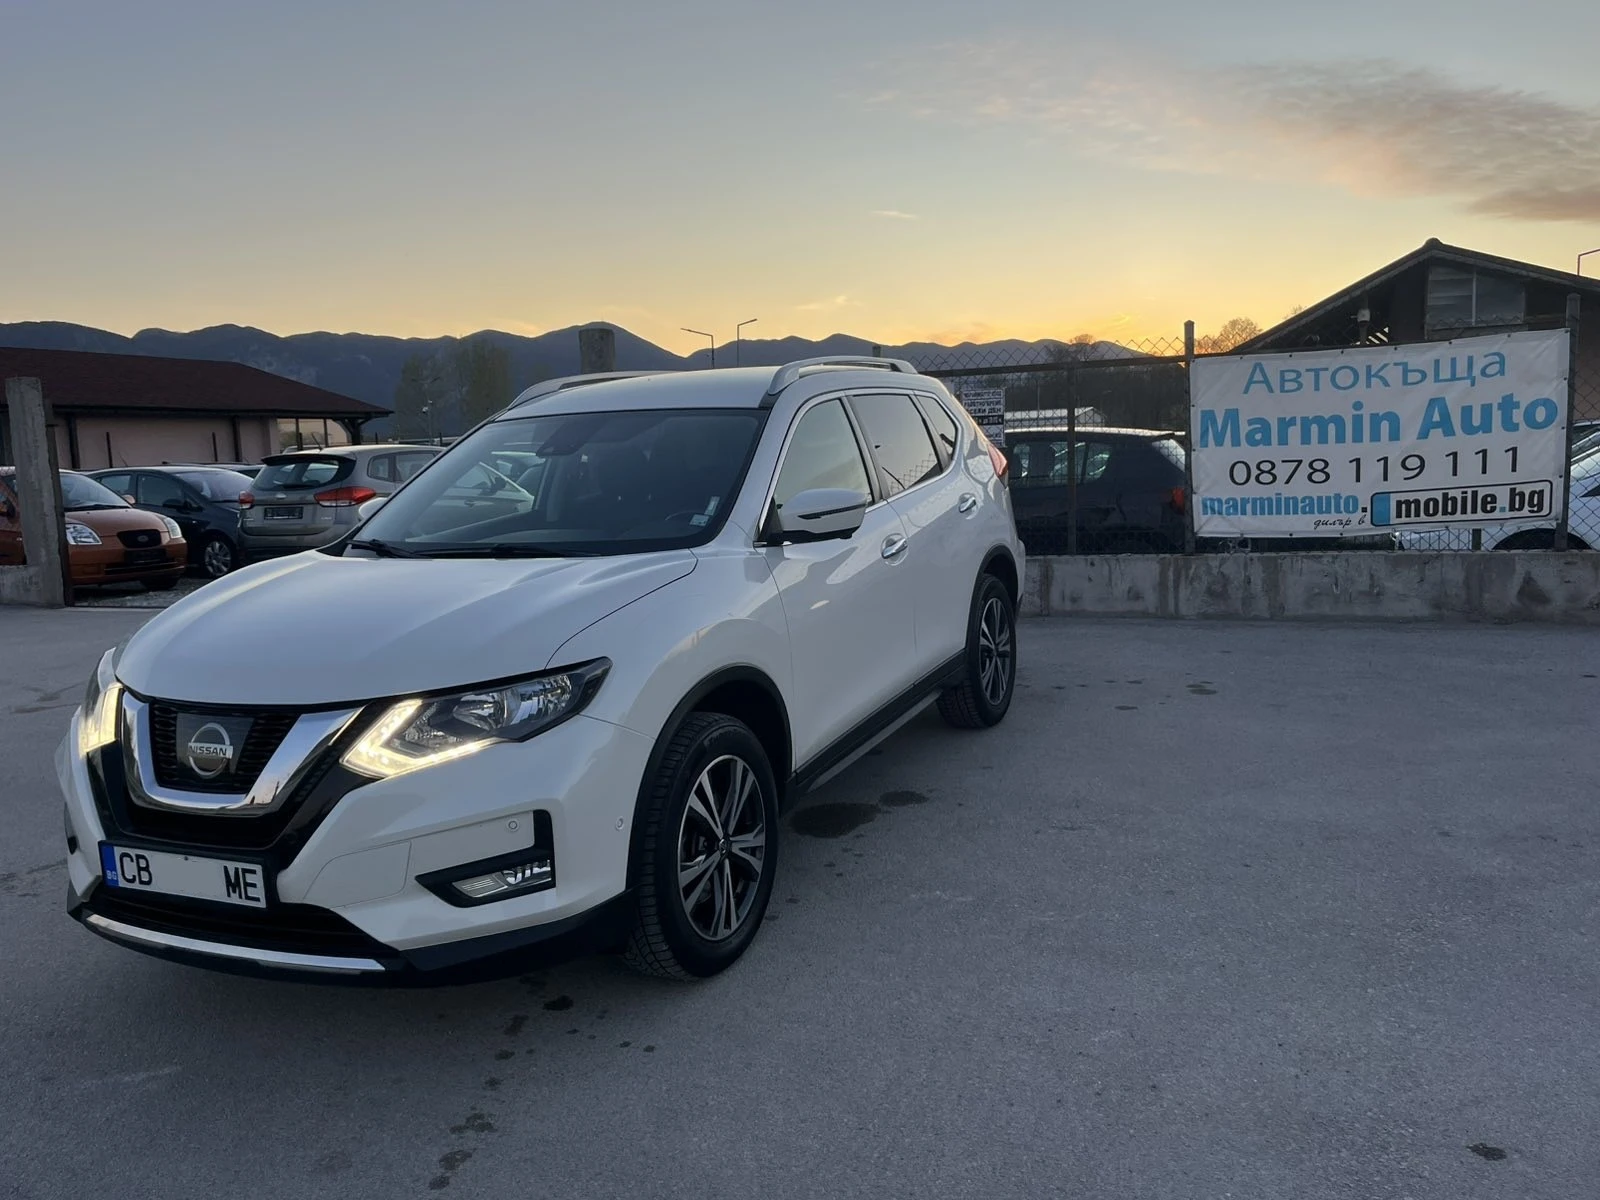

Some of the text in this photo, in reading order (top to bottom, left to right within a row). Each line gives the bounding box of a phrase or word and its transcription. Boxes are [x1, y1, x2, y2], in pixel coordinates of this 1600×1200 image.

[1242, 351, 1506, 395] Автокъща
[1200, 392, 1558, 448] Marmin Auto
[1229, 446, 1518, 486] 0878 119 111
[1395, 487, 1544, 519] mobile.bg
[188, 744, 228, 757] NISSAN
[119, 852, 261, 903] CB ME
